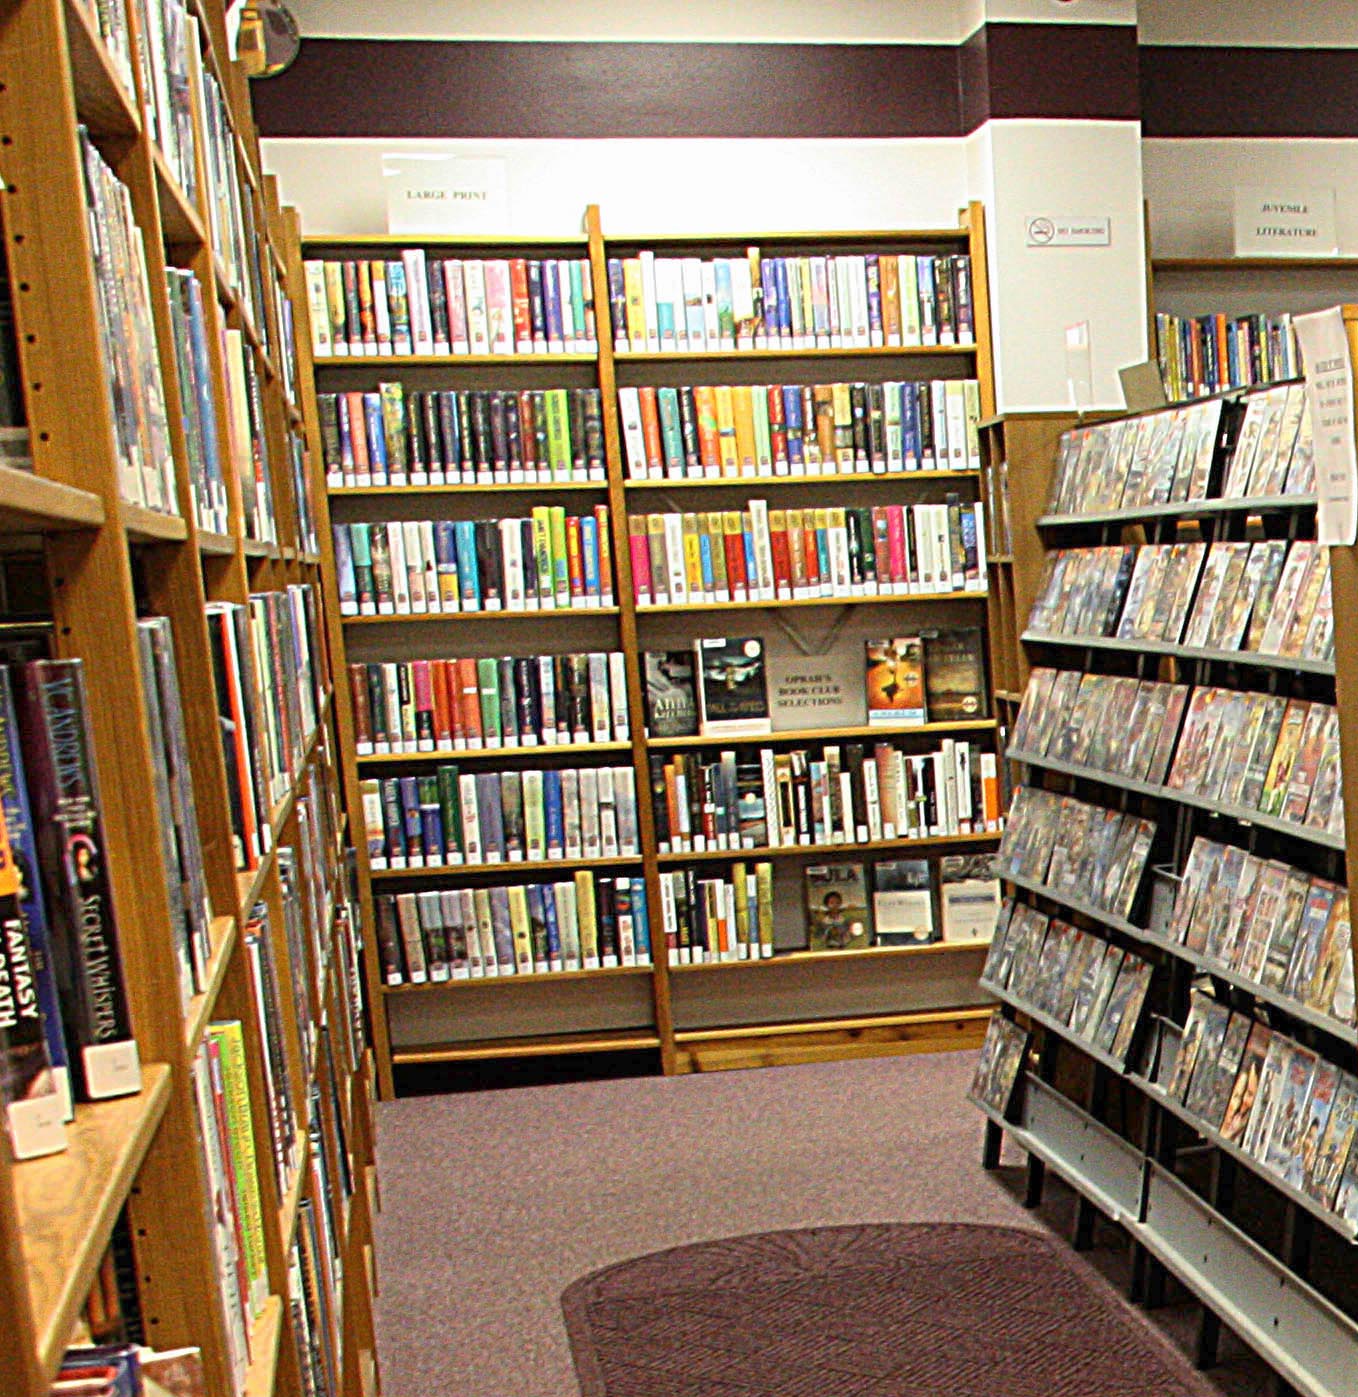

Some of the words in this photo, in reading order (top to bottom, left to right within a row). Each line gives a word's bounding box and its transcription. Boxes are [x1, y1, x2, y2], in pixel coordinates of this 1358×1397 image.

[406, 190, 445, 199] LARGE
[452, 190, 487, 200] PRINT
[1256, 227, 1317, 237] LITERATURE
[784, 673, 832, 684] OPRAH'S
[778, 686, 809, 698] BOOK
[811, 686, 841, 697] CLUB
[777, 697, 844, 708] SELECTIONS
[3, 919, 39, 1020] FANTASY
